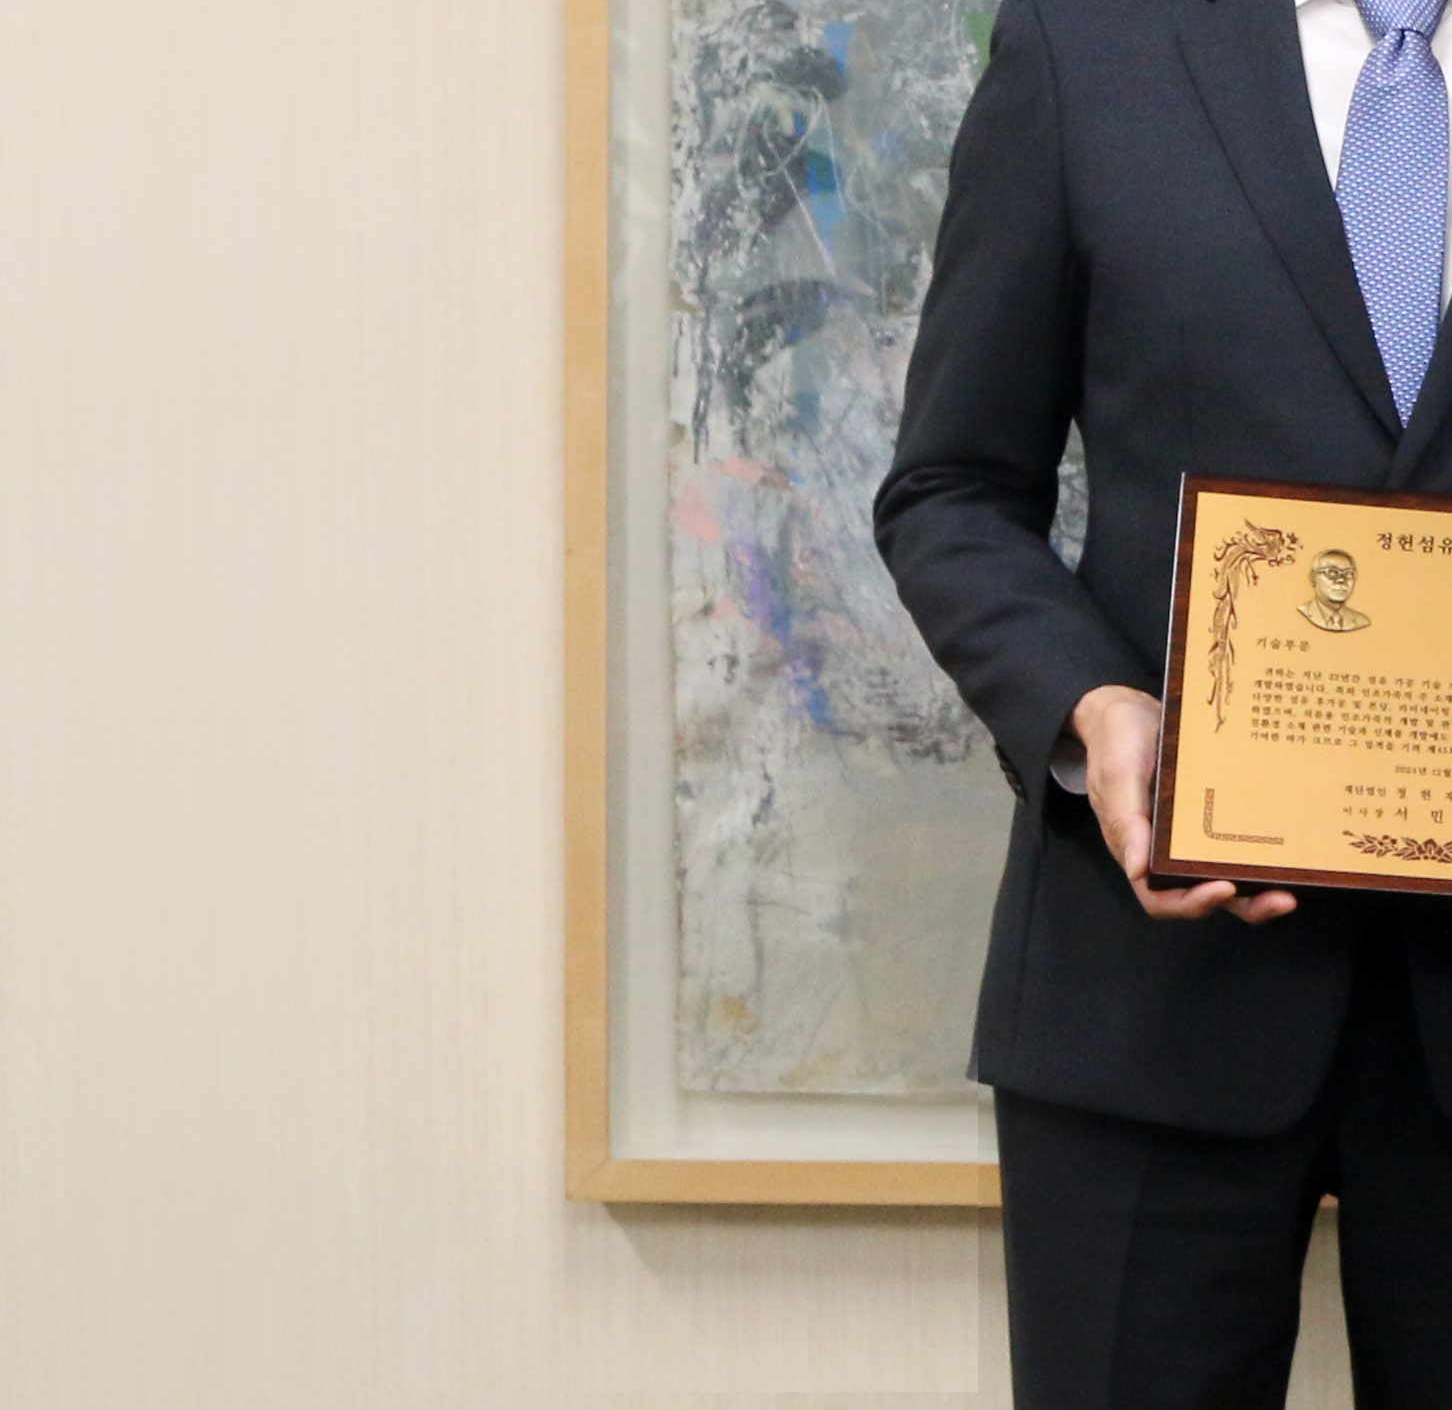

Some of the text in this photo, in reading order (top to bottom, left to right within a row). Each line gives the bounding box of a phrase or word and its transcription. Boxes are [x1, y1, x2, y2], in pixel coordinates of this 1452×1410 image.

[1256, 636, 1309, 651] 기술부문
[1394, 765, 1426, 775] 2024년
[1432, 768, 1451, 778] 12월
[1344, 784, 1386, 797] 재단법인
